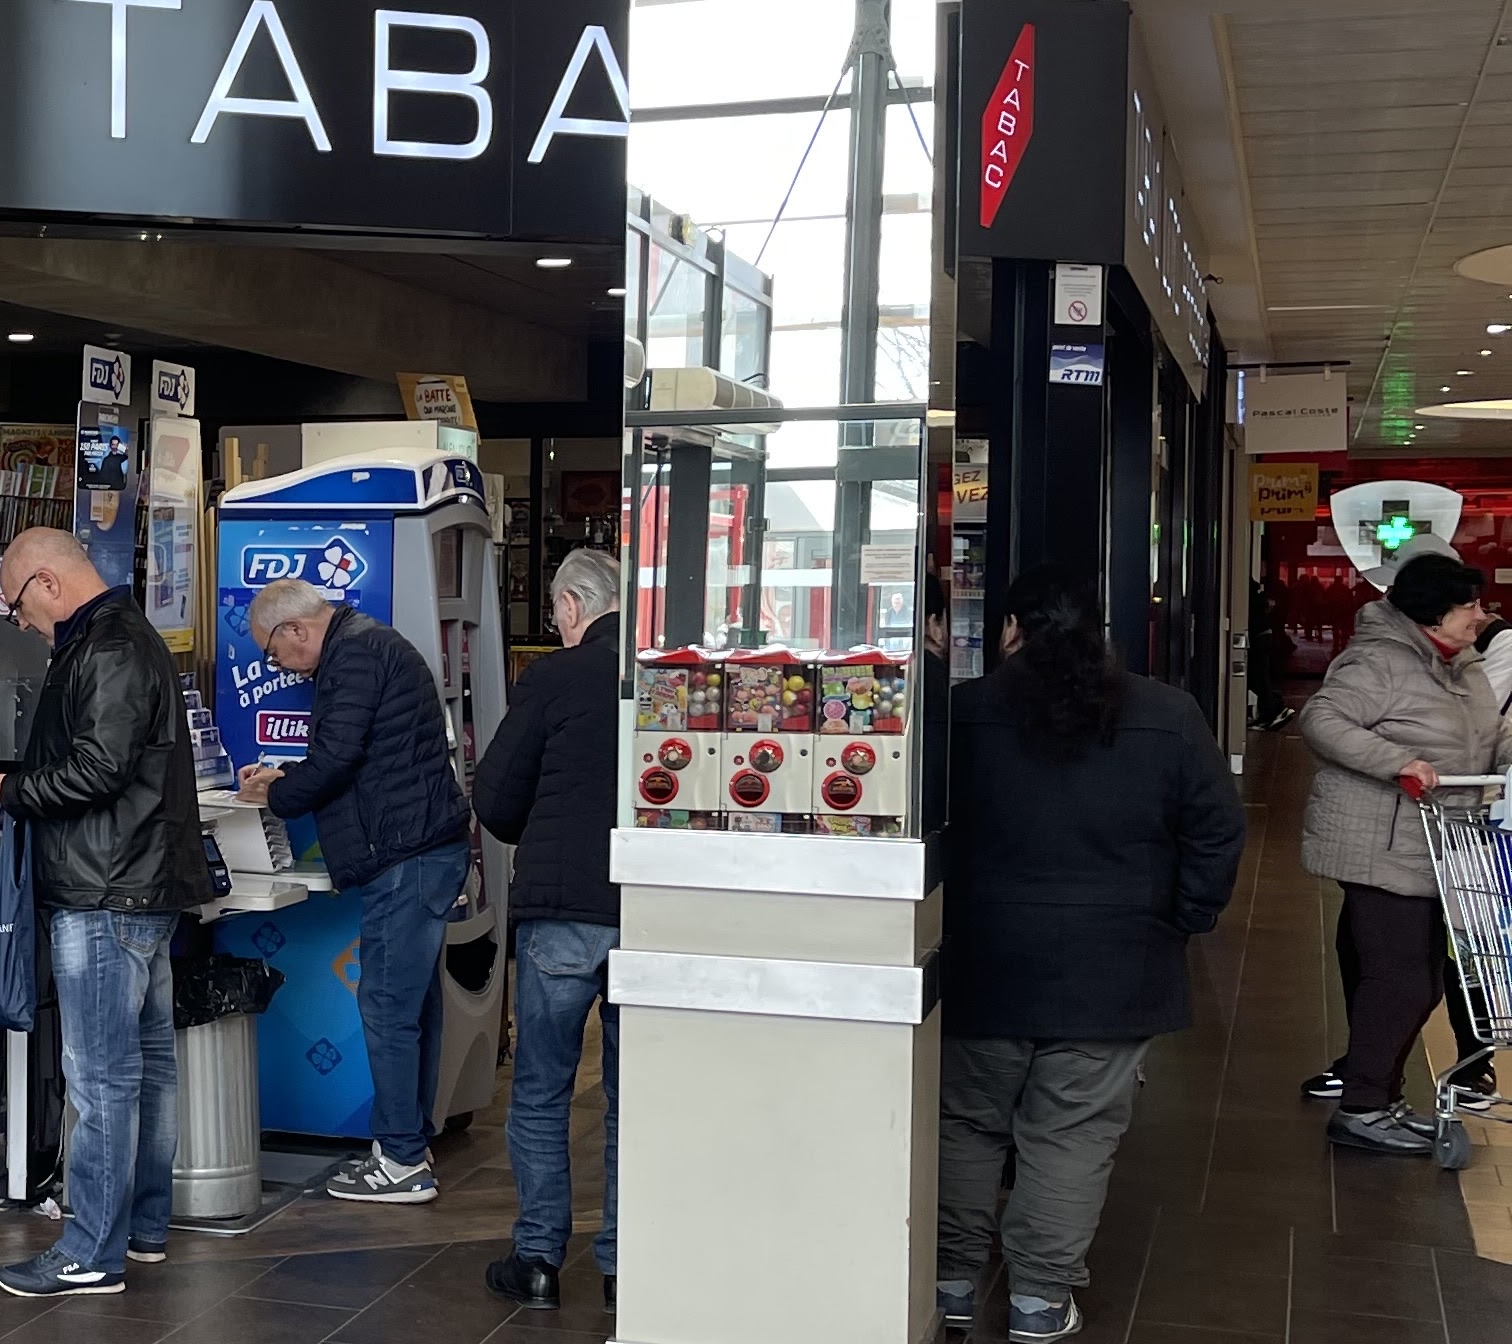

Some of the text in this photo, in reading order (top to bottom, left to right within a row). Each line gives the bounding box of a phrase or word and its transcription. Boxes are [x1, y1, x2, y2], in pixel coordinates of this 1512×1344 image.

[984, 58, 1029, 190] TABAC
[91, 363, 110, 385] FDJ
[1061, 369, 1100, 382] RTM
[159, 376, 175, 396] FDJ
[424, 388, 451, 403] BATTE
[1252, 408, 1296, 417] Pascal
[1300, 407, 1338, 415] Coste
[248, 553, 307, 579] FDJ
[231, 660, 262, 689] La
[238, 689, 251, 708] à
[363, 1169, 389, 1190] N
[62, 1262, 80, 1274] FILA
